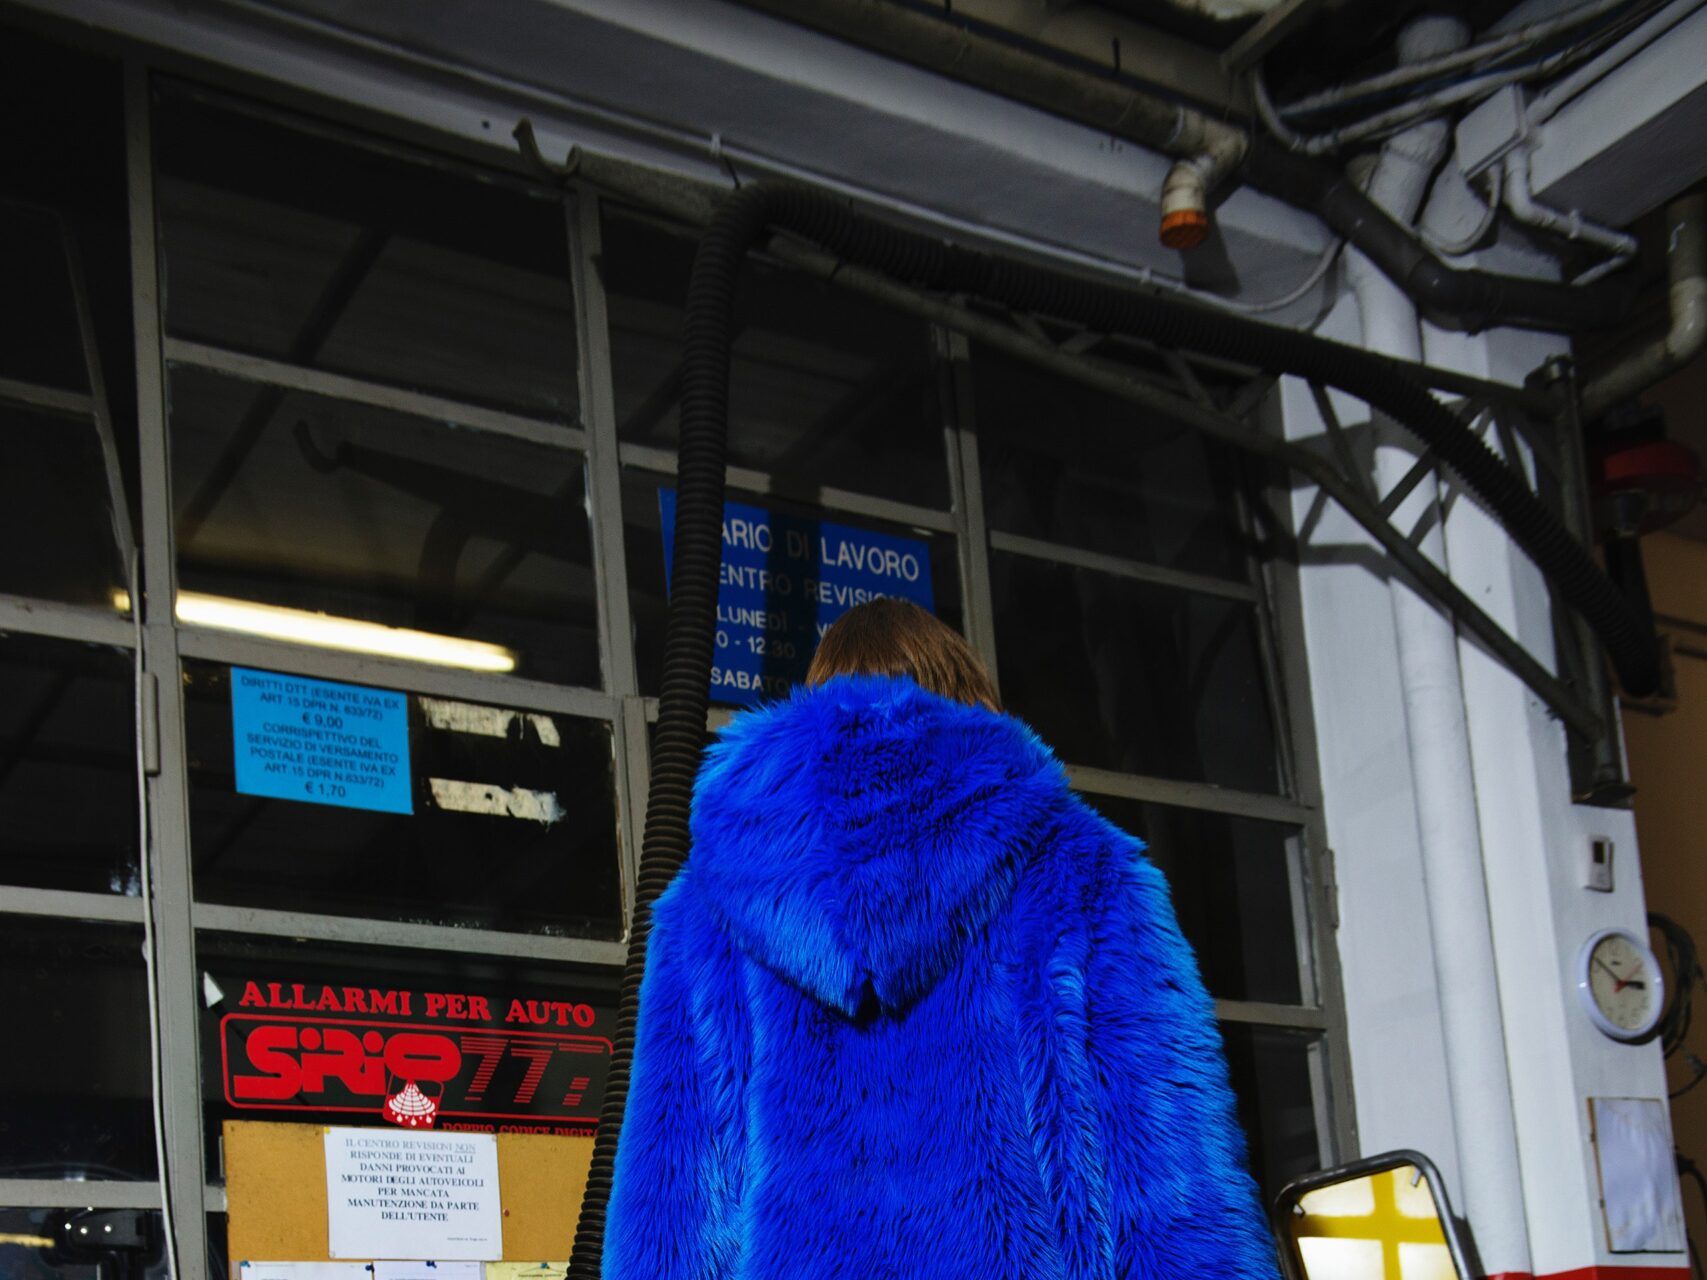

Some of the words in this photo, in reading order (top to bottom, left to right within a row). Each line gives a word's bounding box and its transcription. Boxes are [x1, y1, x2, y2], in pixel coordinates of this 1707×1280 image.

[721, 518, 772, 552] ARIO
[786, 530, 809, 560] DI
[821, 536, 919, 582] LAVORO
[720, 563, 792, 595] ENTRO
[241, 675, 282, 690] DIRITTI
[363, 696, 381, 706] IVA
[384, 699, 399, 710] EX
[263, 722, 357, 744] CORRISPETTIVO
[360, 736, 382, 749] DEL
[247, 733, 301, 750] SERVIZIO
[305, 741, 316, 751] DI
[319, 743, 398, 764] VERSAMENTO
[251, 747, 303, 764] POSTALE
[308, 755, 356, 770] (ESENTE
[360, 763, 378, 773] IVA
[382, 765, 396, 776] EX
[291, 765, 304, 777] 15
[307, 768, 331, 779] DPR
[240, 980, 412, 1017] ALLARMI
[424, 992, 492, 1021] PER
[505, 999, 595, 1028] AUTO
[345, 1138, 357, 1147] IL
[357, 1138, 400, 1149] CENTRO
[402, 1141, 452, 1151] REVISIONI
[455, 1143, 476, 1153] NON
[350, 1150, 401, 1160] RISPONDE
[405, 1152, 417, 1161] DI
[419, 1153, 474, 1163] EVENTUALI
[360, 1163, 393, 1172] DANNI
[396, 1164, 453, 1174] PROVOCATI
[456, 1166, 465, 1175] AI
[341, 1174, 383, 1184] MOTORI
[386, 1175, 415, 1185] DEGLI
[419, 1177, 484, 1187] AUTOVEICOLI
[378, 1187, 397, 1196] PER
[400, 1188, 450, 1198] MANCATA
[348, 1198, 428, 1209] MANUTENZIONE
[430, 1200, 444, 1210] DA
[447, 1201, 479, 1211] PARTE
[381, 1211, 448, 1222] DELL'UTENTE
